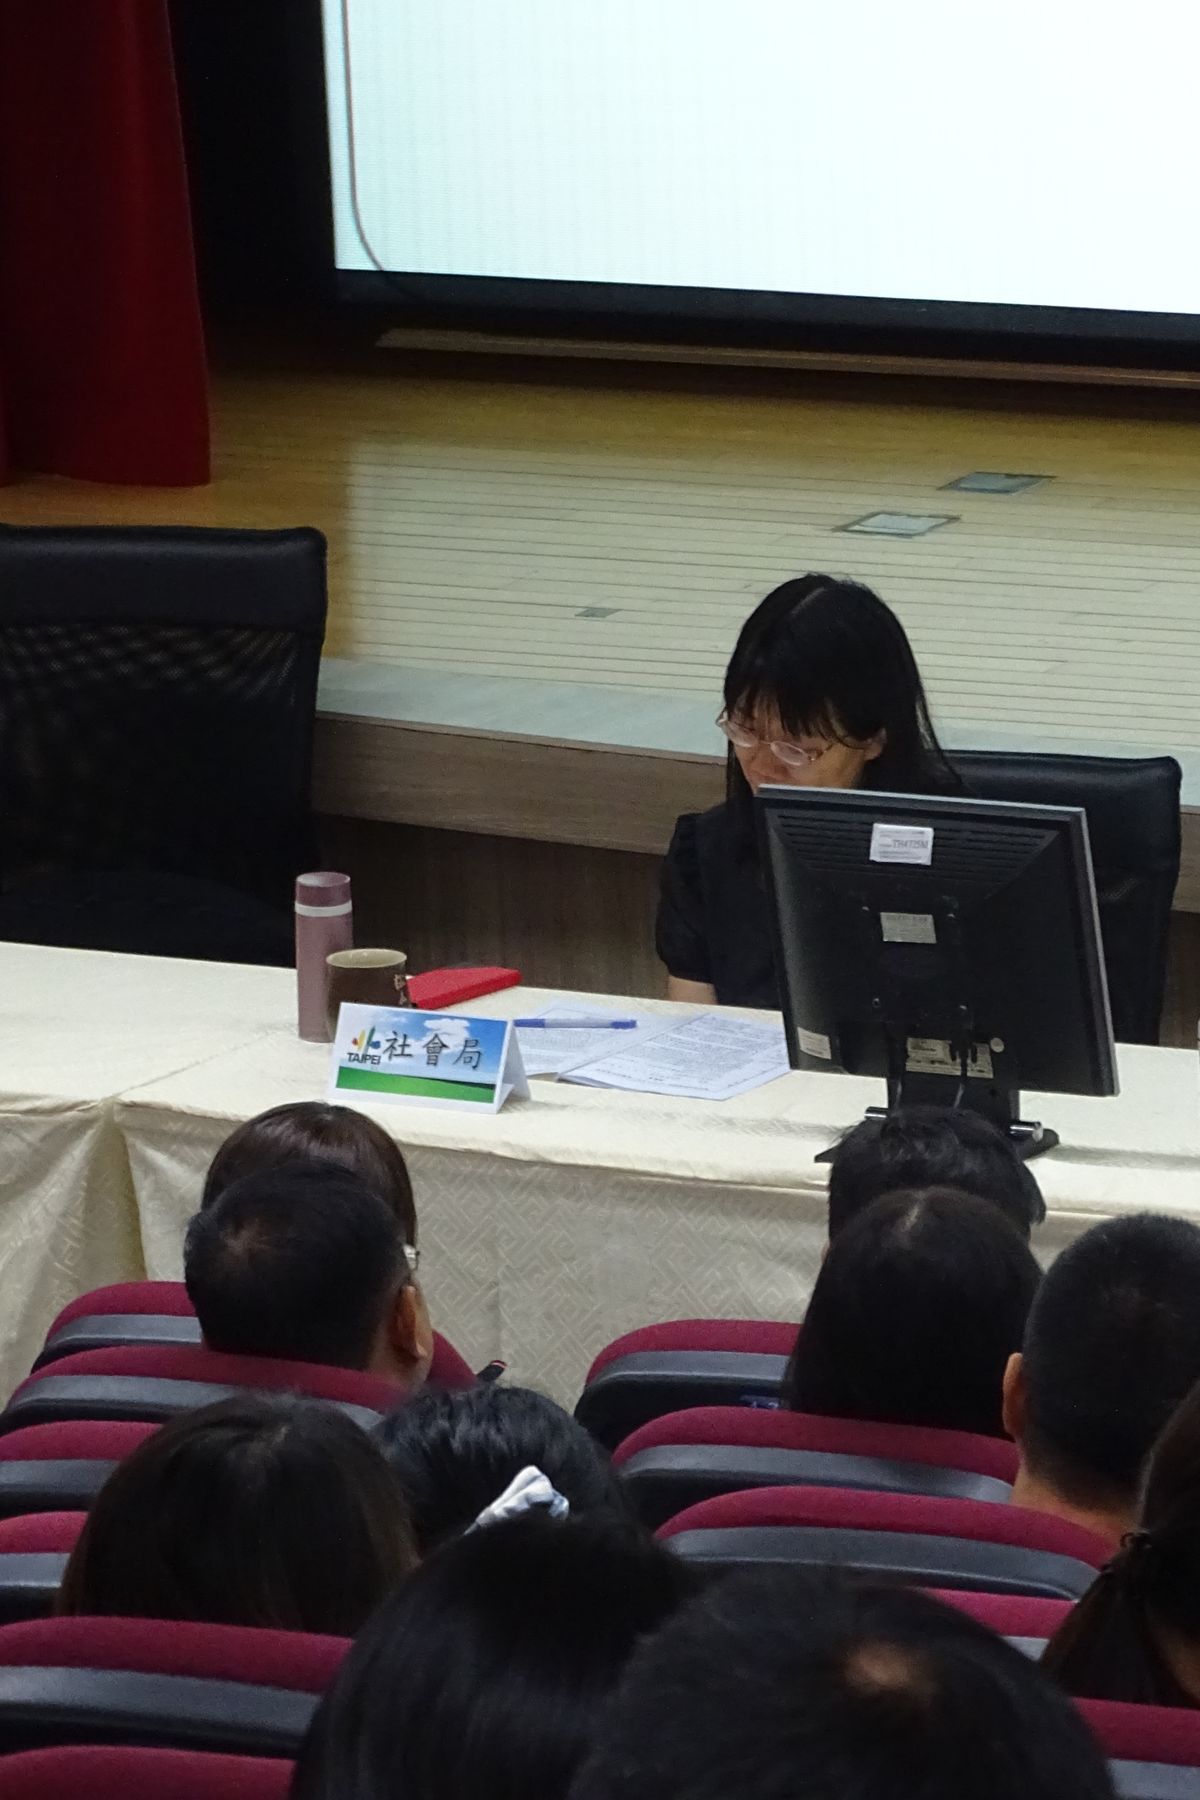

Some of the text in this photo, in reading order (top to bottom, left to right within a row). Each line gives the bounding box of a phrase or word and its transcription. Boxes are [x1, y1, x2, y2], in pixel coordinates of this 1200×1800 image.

[347, 1052, 381, 1065] TAIPEI
[383, 1031, 482, 1070] 社會局
